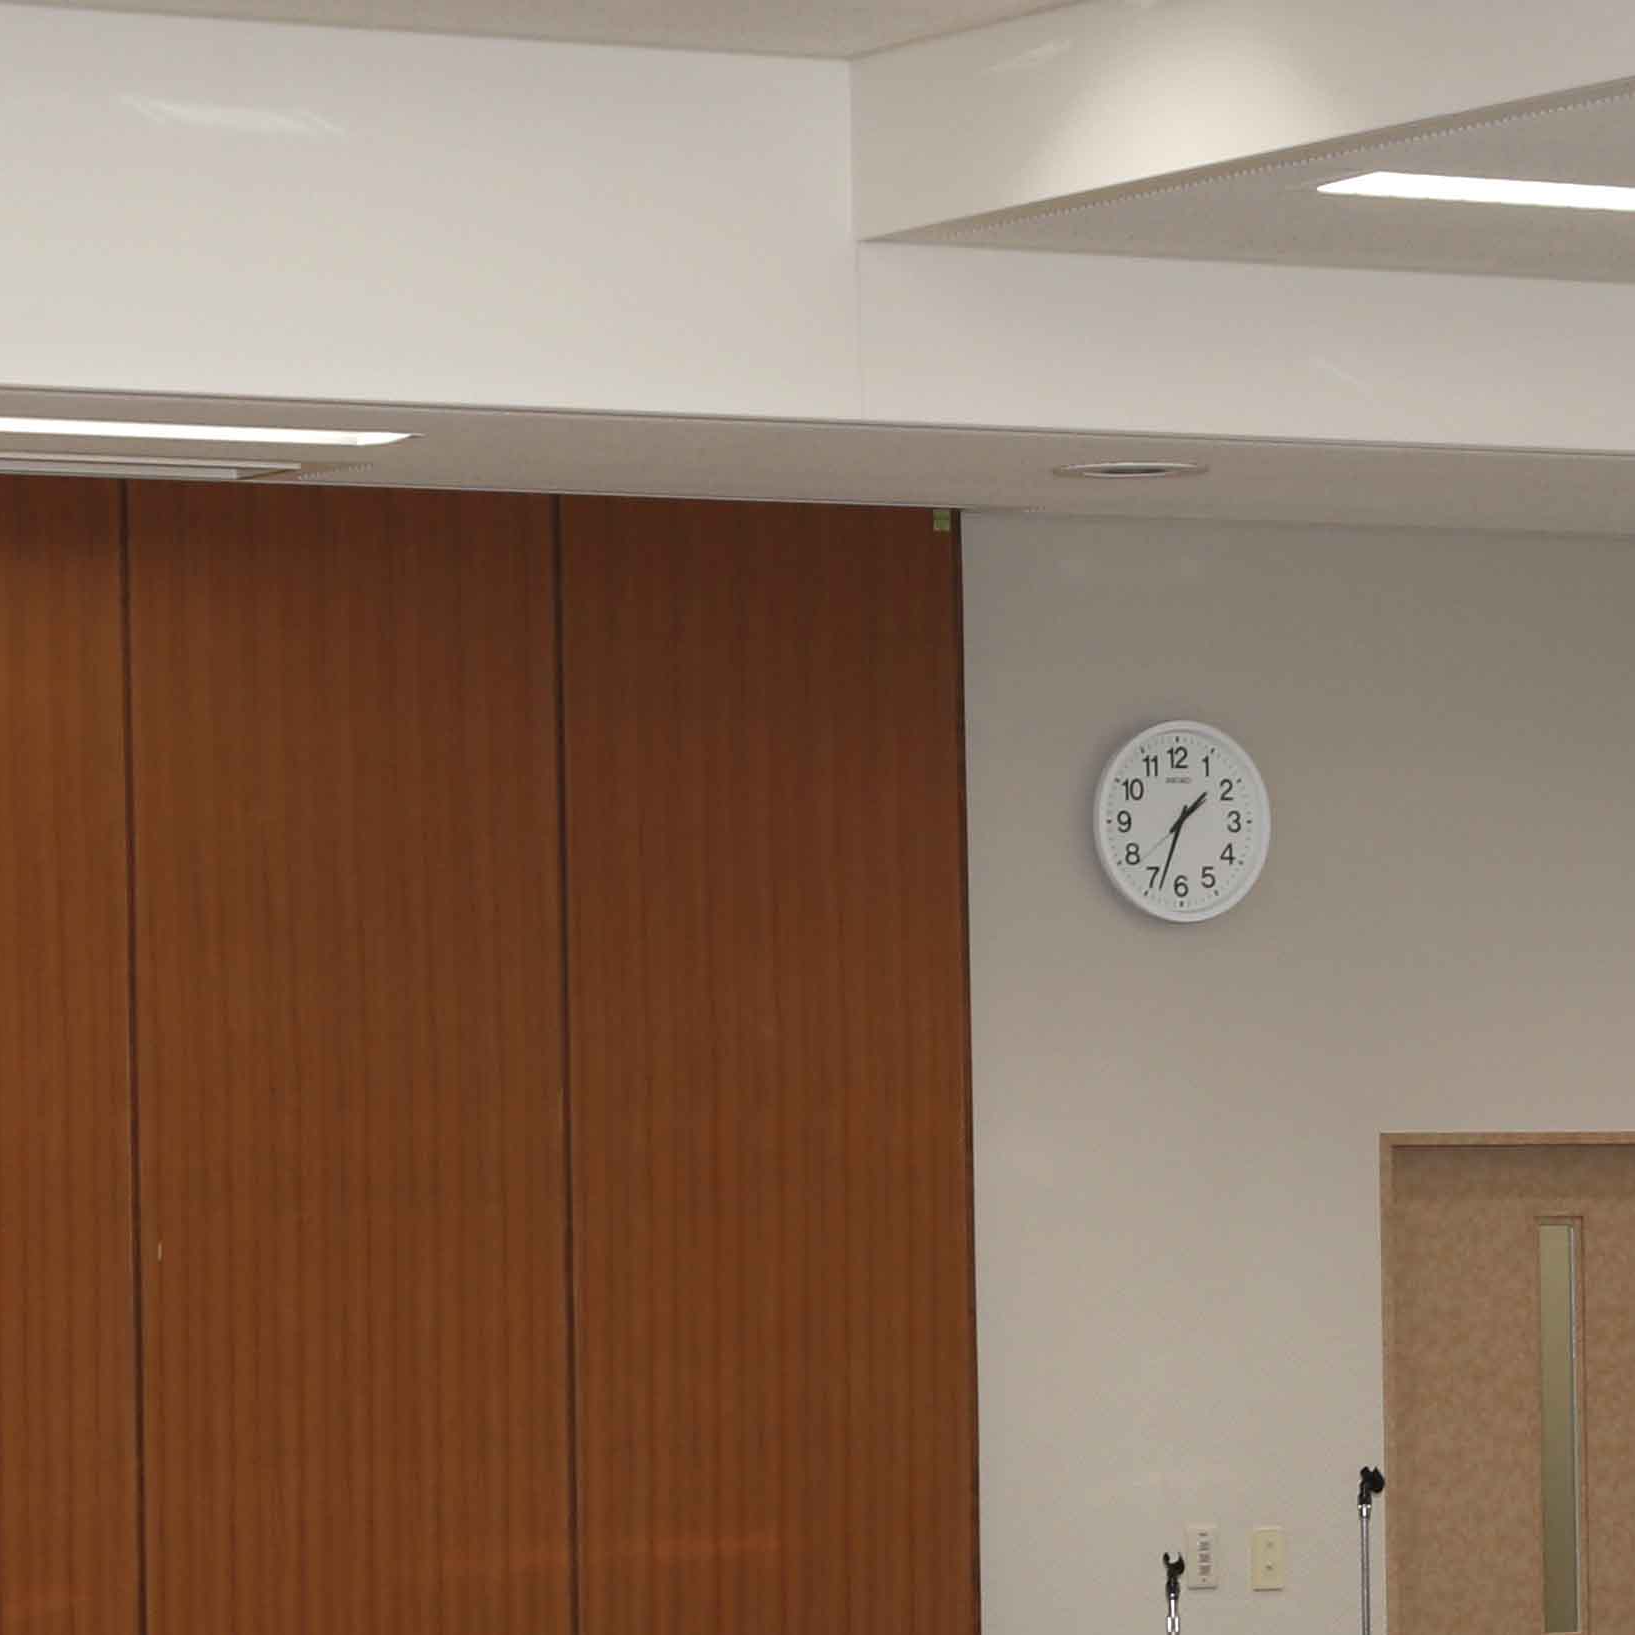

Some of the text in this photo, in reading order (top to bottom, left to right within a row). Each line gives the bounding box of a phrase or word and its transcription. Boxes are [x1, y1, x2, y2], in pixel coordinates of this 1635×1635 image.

[1142, 755, 1159, 777] 11
[1167, 746, 1189, 769] 12
[1202, 756, 1210, 777] 1
[1121, 778, 1144, 800] 10
[1220, 779, 1234, 801] 2
[1117, 810, 1132, 833] 9
[1227, 810, 1242, 833] 3
[1125, 843, 1141, 865] 8
[1220, 844, 1236, 865] 4
[1146, 867, 1160, 888] 7
[1174, 875, 1189, 897] 6
[1201, 866, 1216, 888] 5
